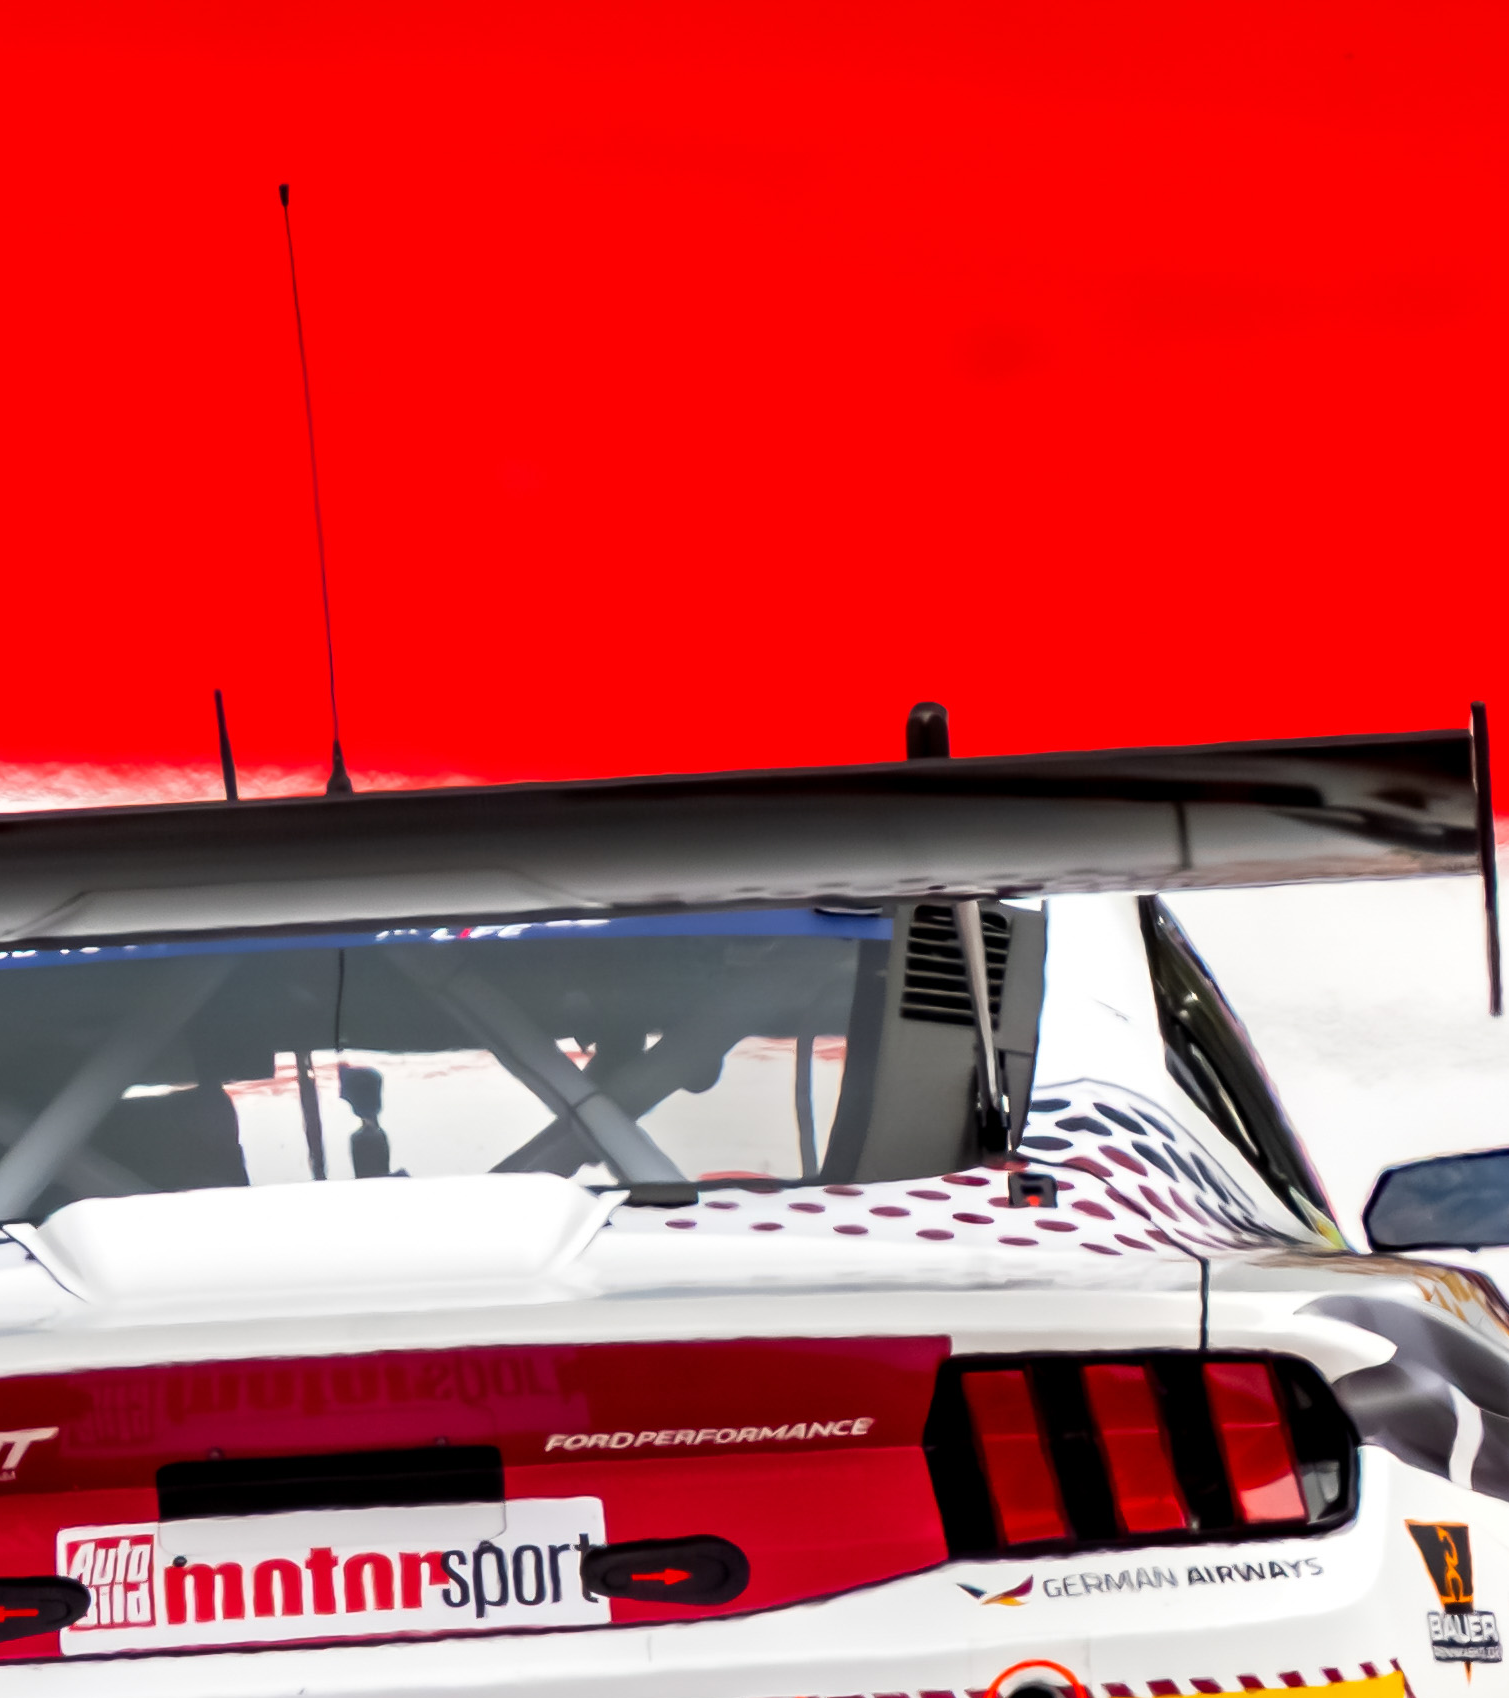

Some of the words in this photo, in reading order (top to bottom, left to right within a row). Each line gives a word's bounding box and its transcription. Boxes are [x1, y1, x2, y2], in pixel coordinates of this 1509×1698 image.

[70, 1538, 153, 1586] Auto
[1043, 1566, 1181, 1600] GERMAN
[1186, 1555, 1326, 1587] AIRWAYS
[1429, 1612, 1500, 1644] BAUER
